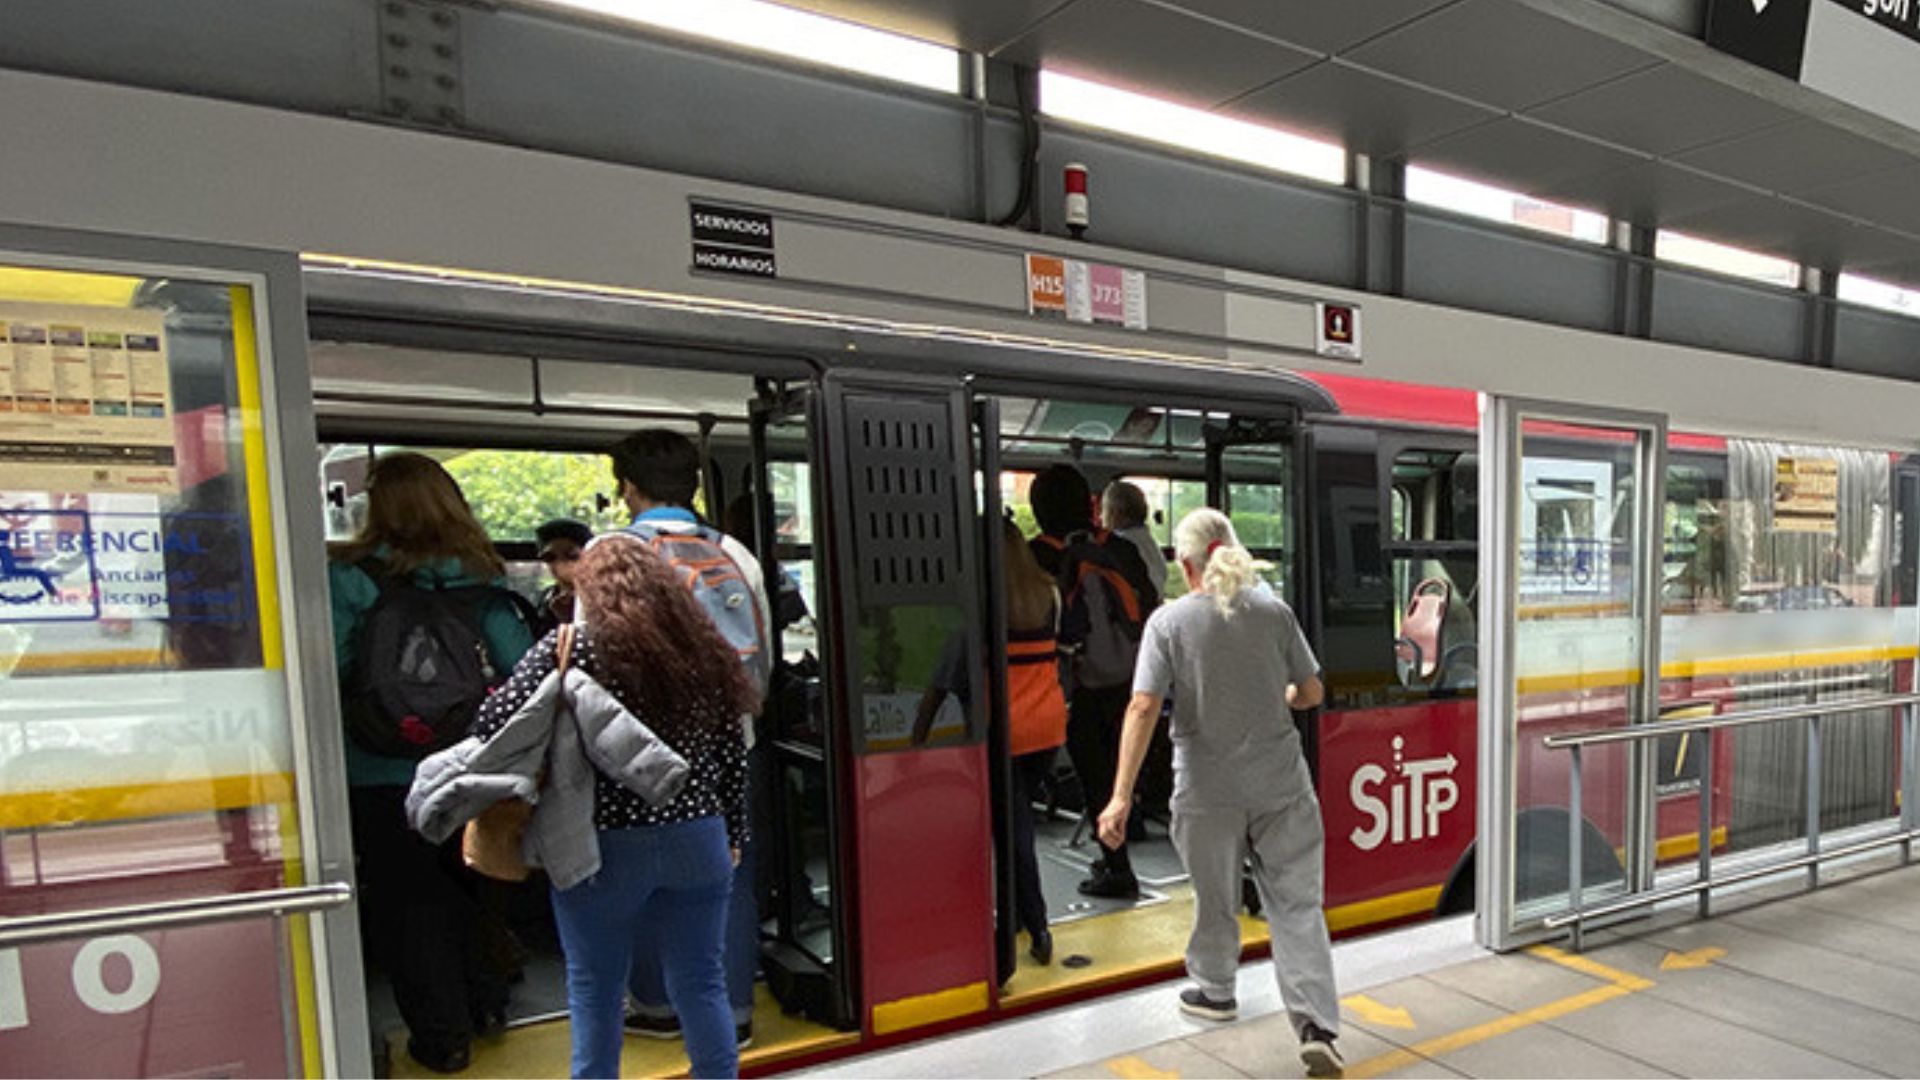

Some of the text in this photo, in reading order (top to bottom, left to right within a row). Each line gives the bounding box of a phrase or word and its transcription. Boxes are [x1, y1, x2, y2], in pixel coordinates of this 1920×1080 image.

[694, 213, 769, 235] SERVICIOS
[696, 252, 775, 273] HORARIOS
[1031, 274, 1065, 296] H15
